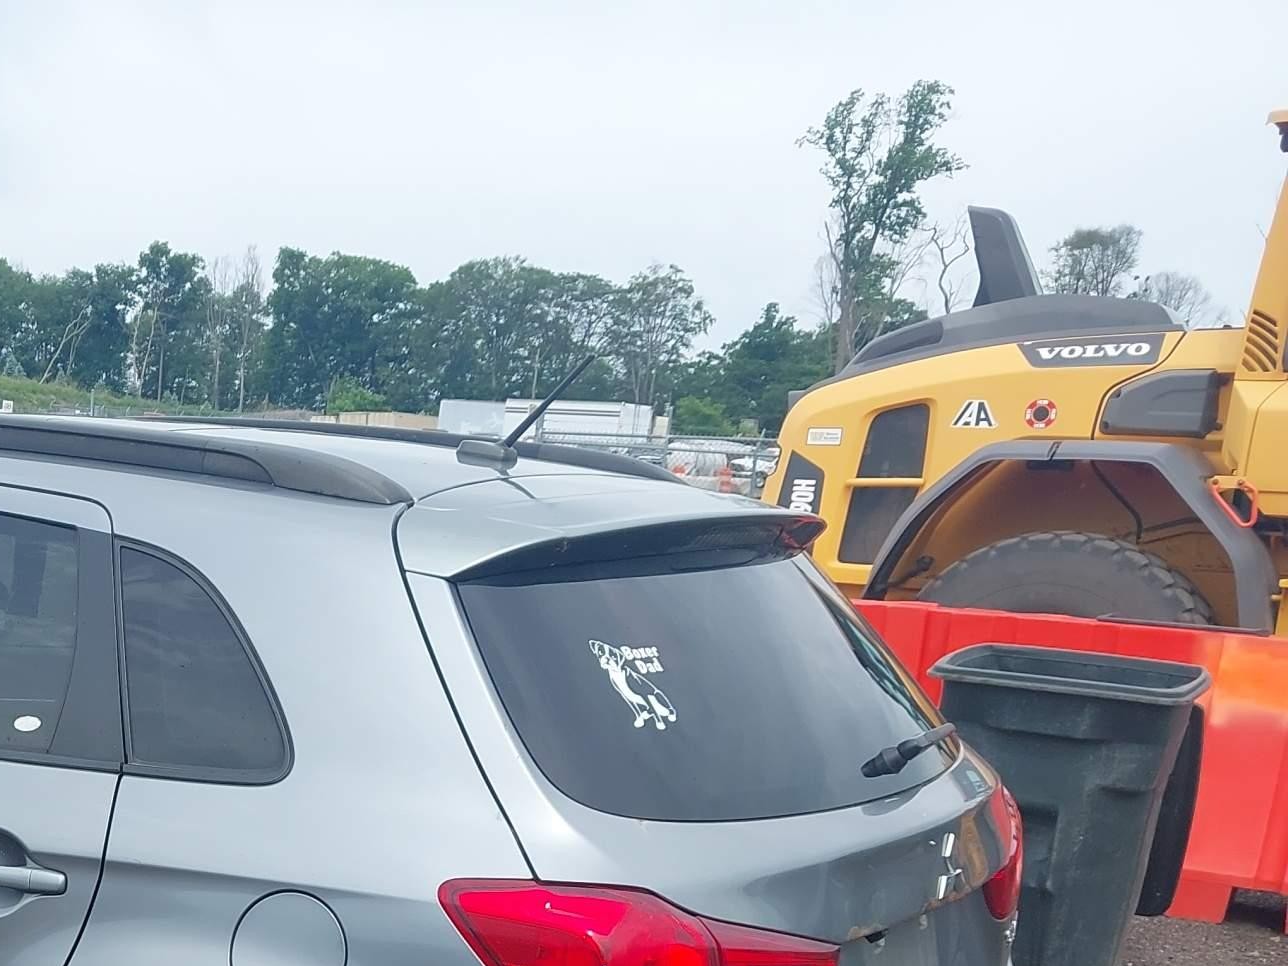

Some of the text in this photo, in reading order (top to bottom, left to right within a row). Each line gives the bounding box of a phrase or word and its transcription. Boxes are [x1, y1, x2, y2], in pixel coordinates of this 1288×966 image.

[1036, 342, 1151, 360] VOLVO
[620, 645, 660, 660] Boxer
[634, 657, 665, 674] Dad
